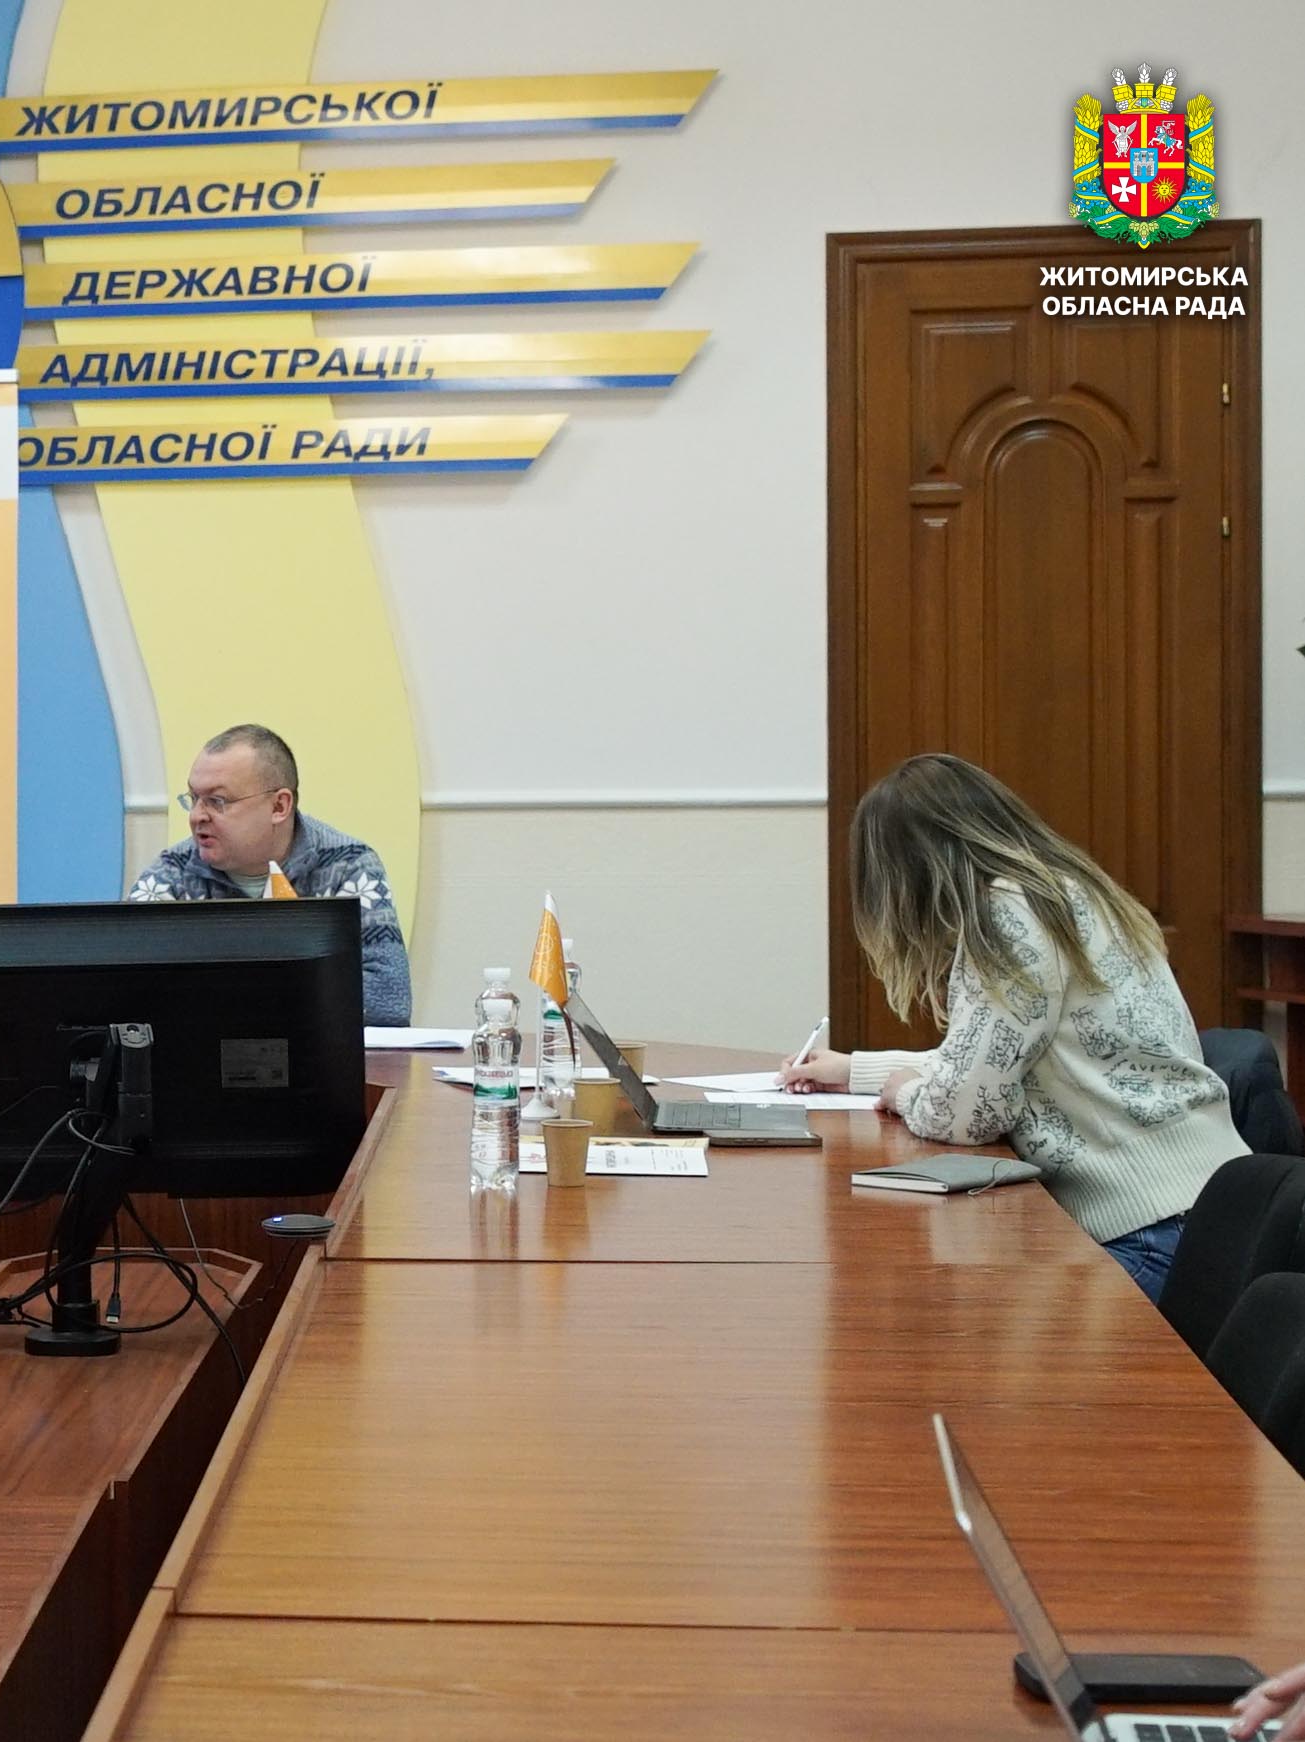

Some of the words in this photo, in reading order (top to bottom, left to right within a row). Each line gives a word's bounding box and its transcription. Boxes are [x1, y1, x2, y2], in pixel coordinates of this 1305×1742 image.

[16, 82, 444, 137] ЖИТОМИРСЬКОЇ
[55, 172, 326, 220] ОБЛАСНОЇ
[62, 257, 375, 306] ДЕРЖАВНОЇ
[39, 338, 435, 387] АДМІНІСТРАЦІЇ,
[18, 424, 277, 470] ОБЛАСНОЇ
[291, 426, 432, 463] РАДИ
